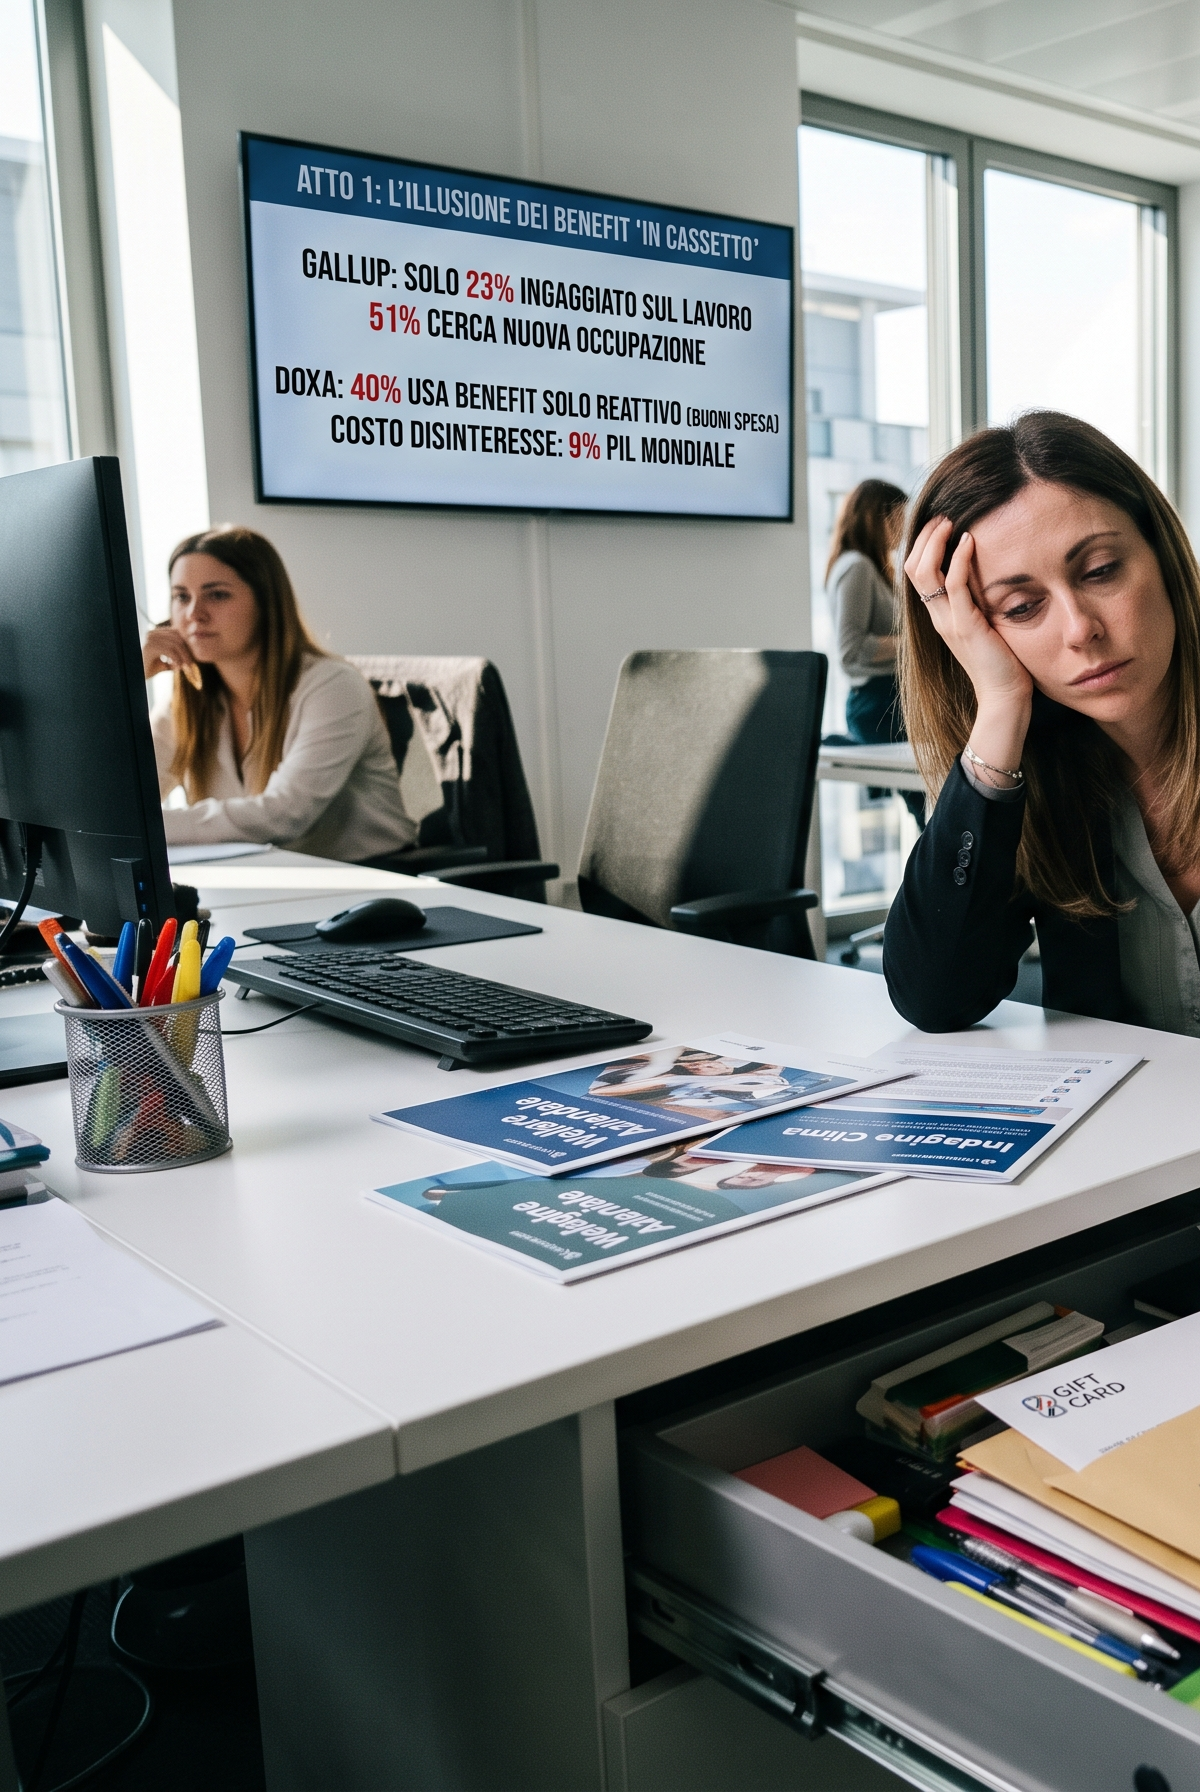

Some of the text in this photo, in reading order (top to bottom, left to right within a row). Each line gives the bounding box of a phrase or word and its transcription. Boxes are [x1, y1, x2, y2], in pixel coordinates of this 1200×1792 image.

[297, 165, 354, 199] ATTO
[362, 176, 381, 204] 1:
[516, 200, 548, 229] DEI
[553, 206, 631, 242] BENEFIT
[302, 248, 752, 331] GALLUP: SOLO 23% INGAGGIATO SUL LAVORO
[369, 302, 706, 365] 51% CERCA NUOVA OCCUPAZIONE
[275, 366, 344, 398] DOXA:
[349, 373, 402, 404] 40%
[407, 378, 450, 407] USA
[455, 382, 538, 413] BENEFIT
[542, 390, 591, 418] SOLO
[596, 395, 682, 425] REATTIVO
[330, 415, 736, 468] COSTO DISINTERESSE: 9% PIL MONDIALE
[782, 1127, 1015, 1153] Indagine Clima
[1053, 1373, 1101, 1398] GIFT
[1068, 1381, 1125, 1408] CARD
